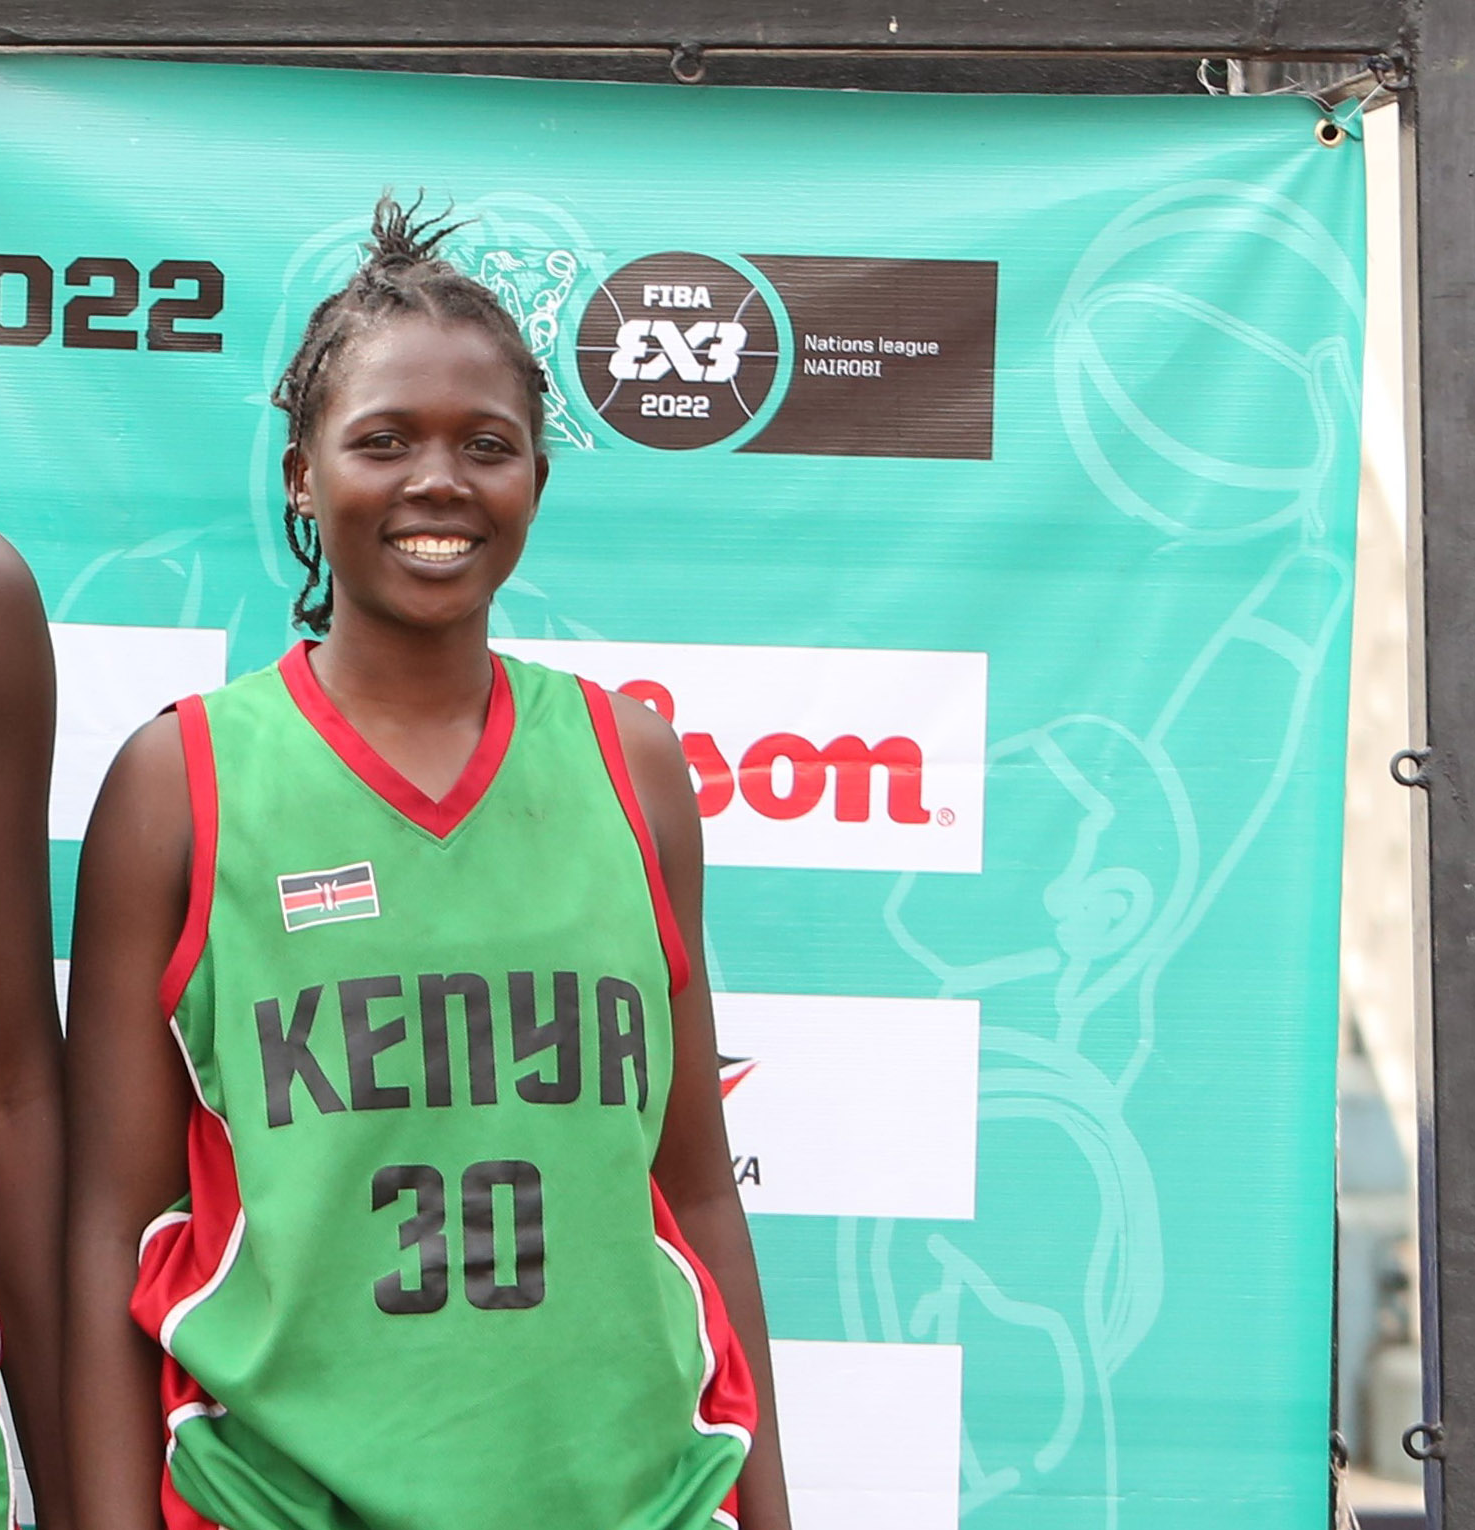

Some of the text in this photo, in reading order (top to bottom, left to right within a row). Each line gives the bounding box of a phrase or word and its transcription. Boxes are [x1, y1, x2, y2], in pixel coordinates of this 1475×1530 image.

[642, 284, 712, 310] FIBA
[804, 333, 940, 358] Nations league
[803, 358, 883, 378] NAIROBI
[640, 393, 711, 419] 2022
[253, 970, 649, 1129] KENYA
[369, 1158, 546, 1316] 30
